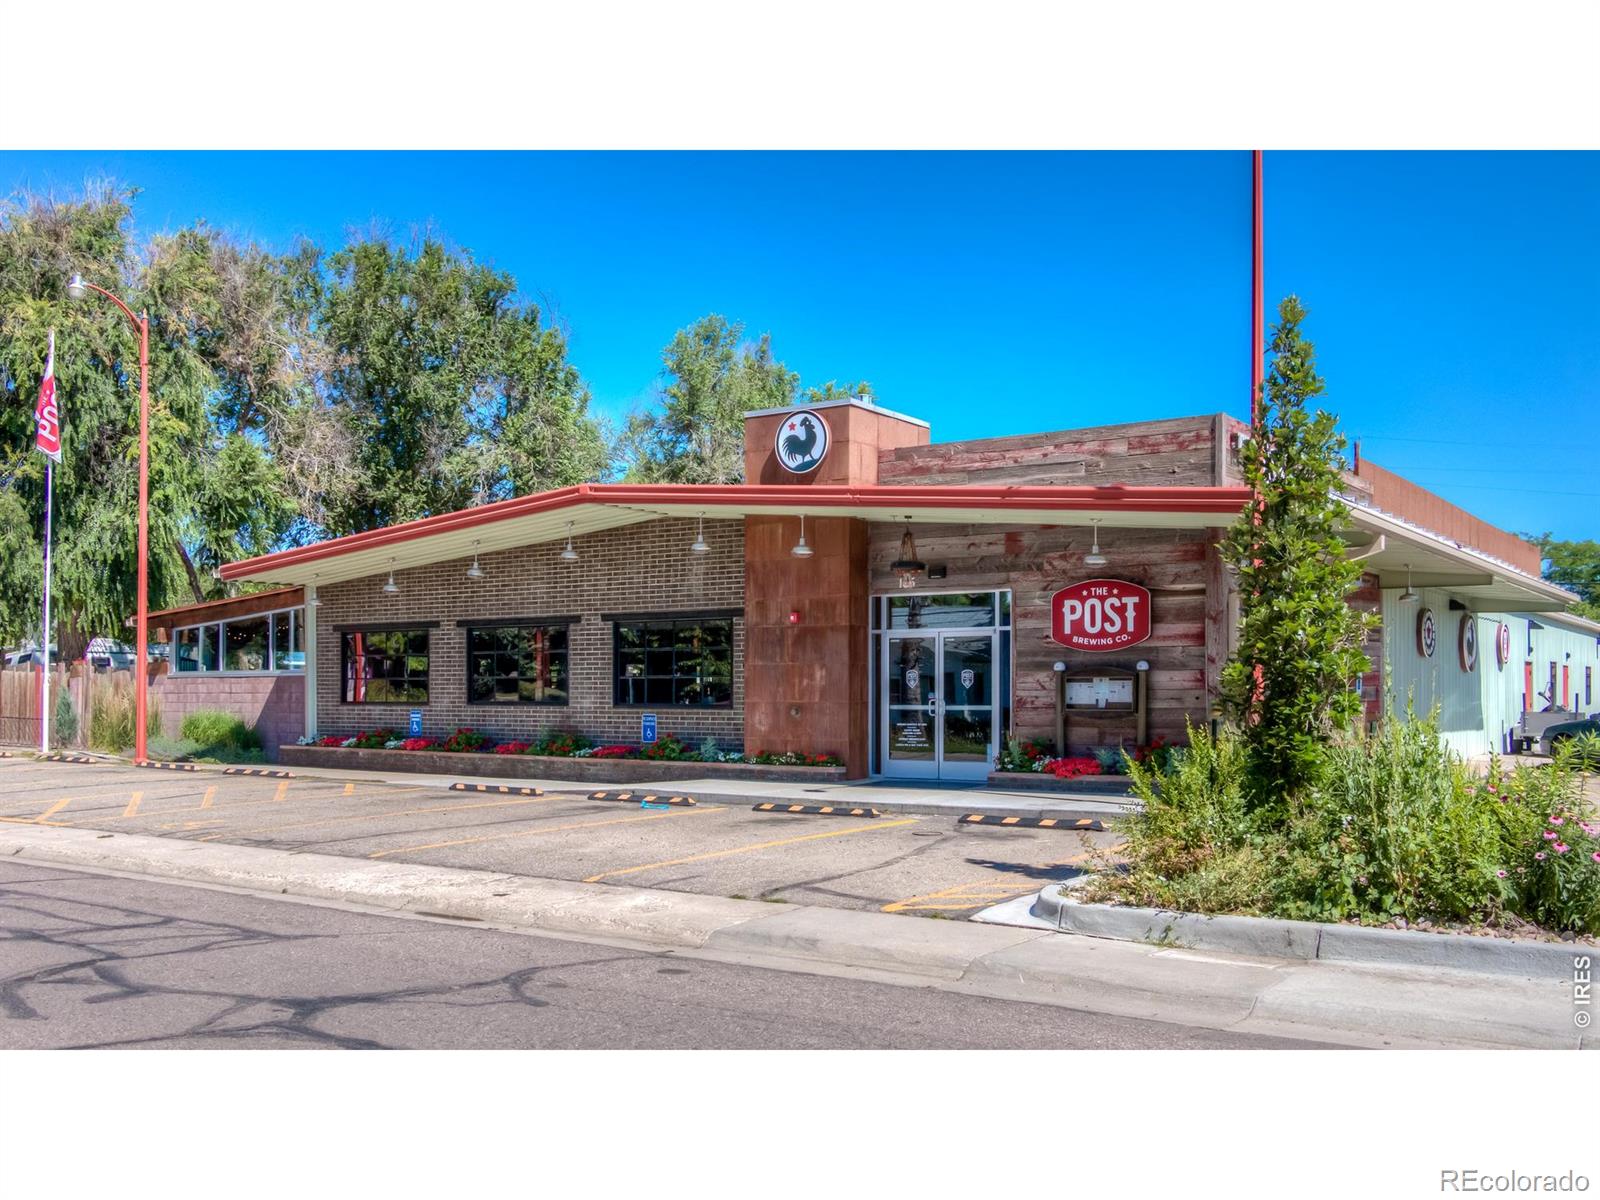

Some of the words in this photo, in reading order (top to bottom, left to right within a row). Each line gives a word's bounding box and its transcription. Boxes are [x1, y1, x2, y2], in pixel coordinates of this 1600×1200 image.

[1090, 587, 1108, 596] THE
[1062, 597, 1139, 634] POST
[1072, 635, 1113, 645] BREWING
[1116, 634, 1131, 643] CO.
